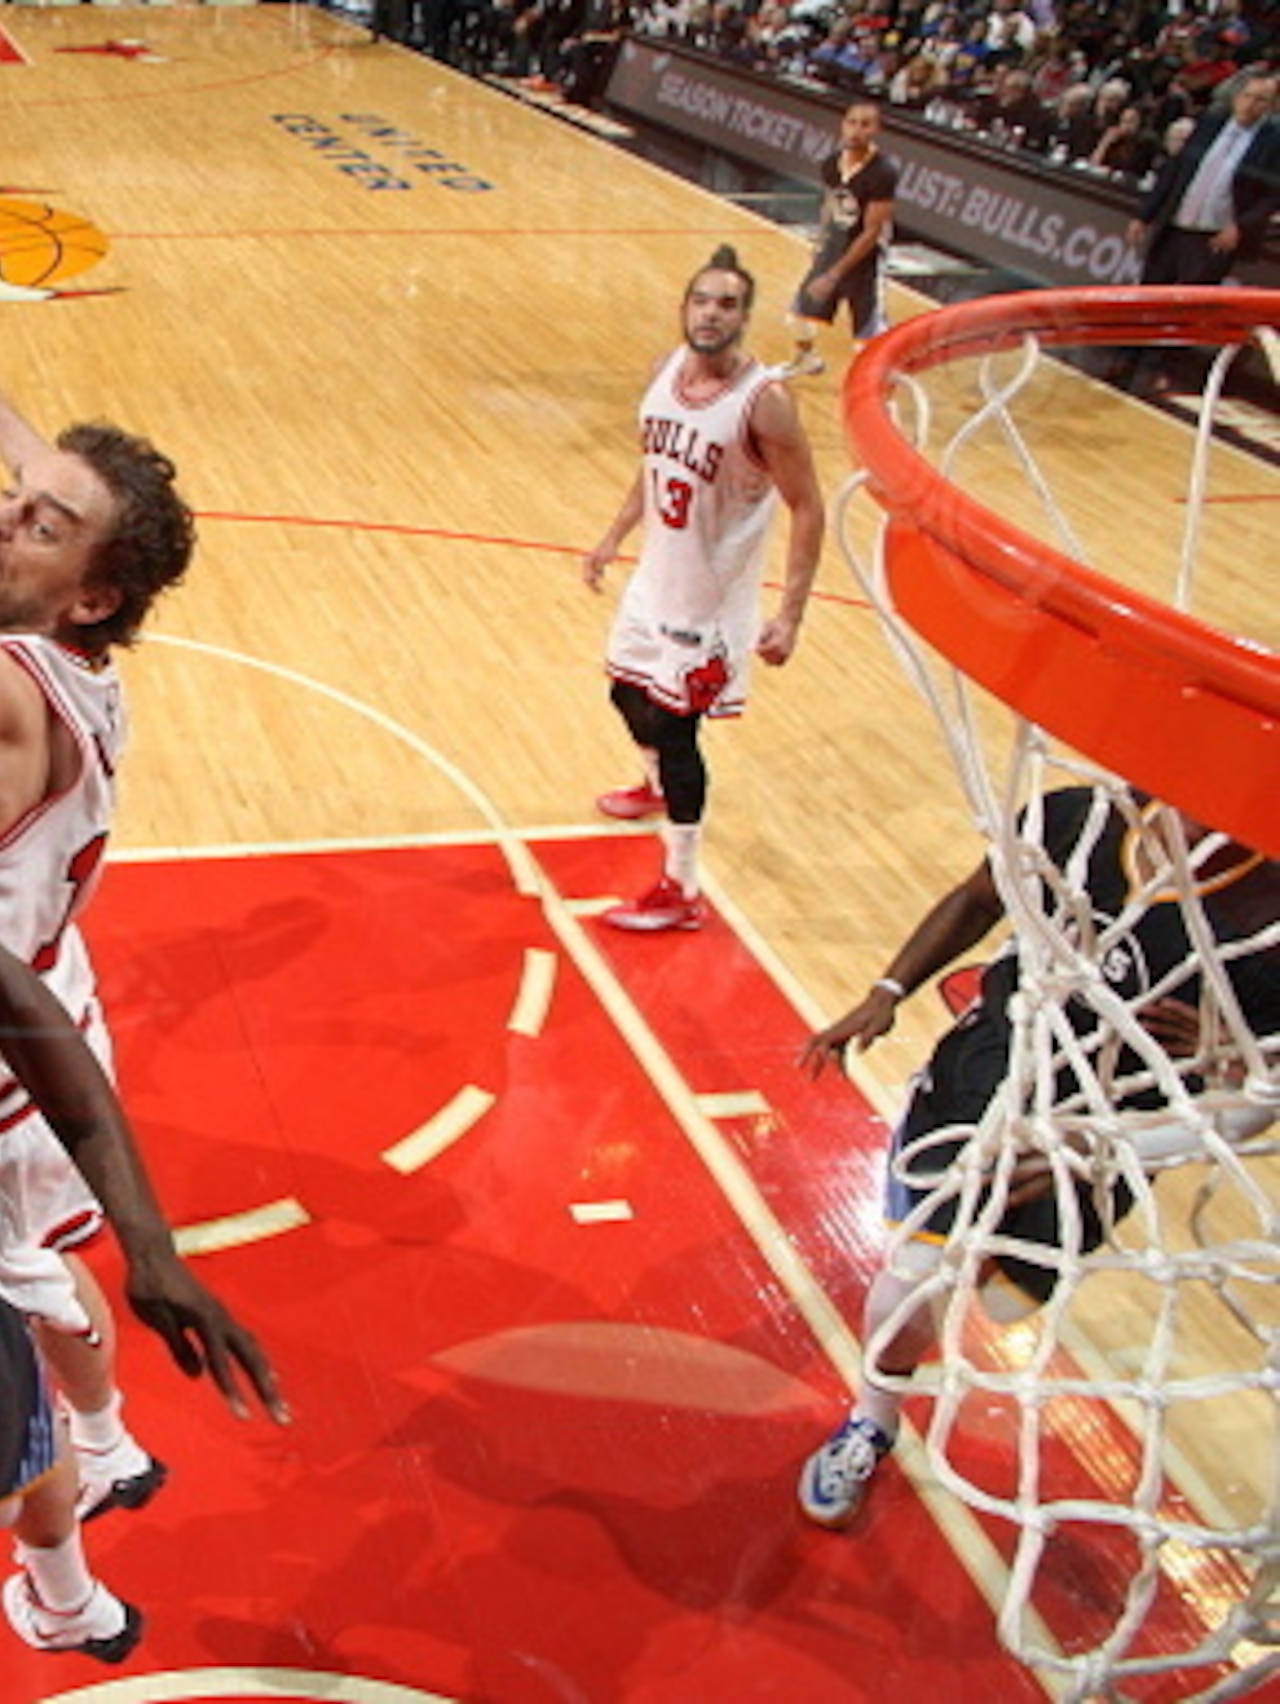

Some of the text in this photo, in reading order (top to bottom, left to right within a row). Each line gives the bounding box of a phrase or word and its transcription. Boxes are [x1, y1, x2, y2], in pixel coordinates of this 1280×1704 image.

[657, 73, 732, 125] SEASON
[728, 98, 804, 151] TICKET
[269, 113, 412, 190] CENTER
[338, 113, 495, 190] UNITED
